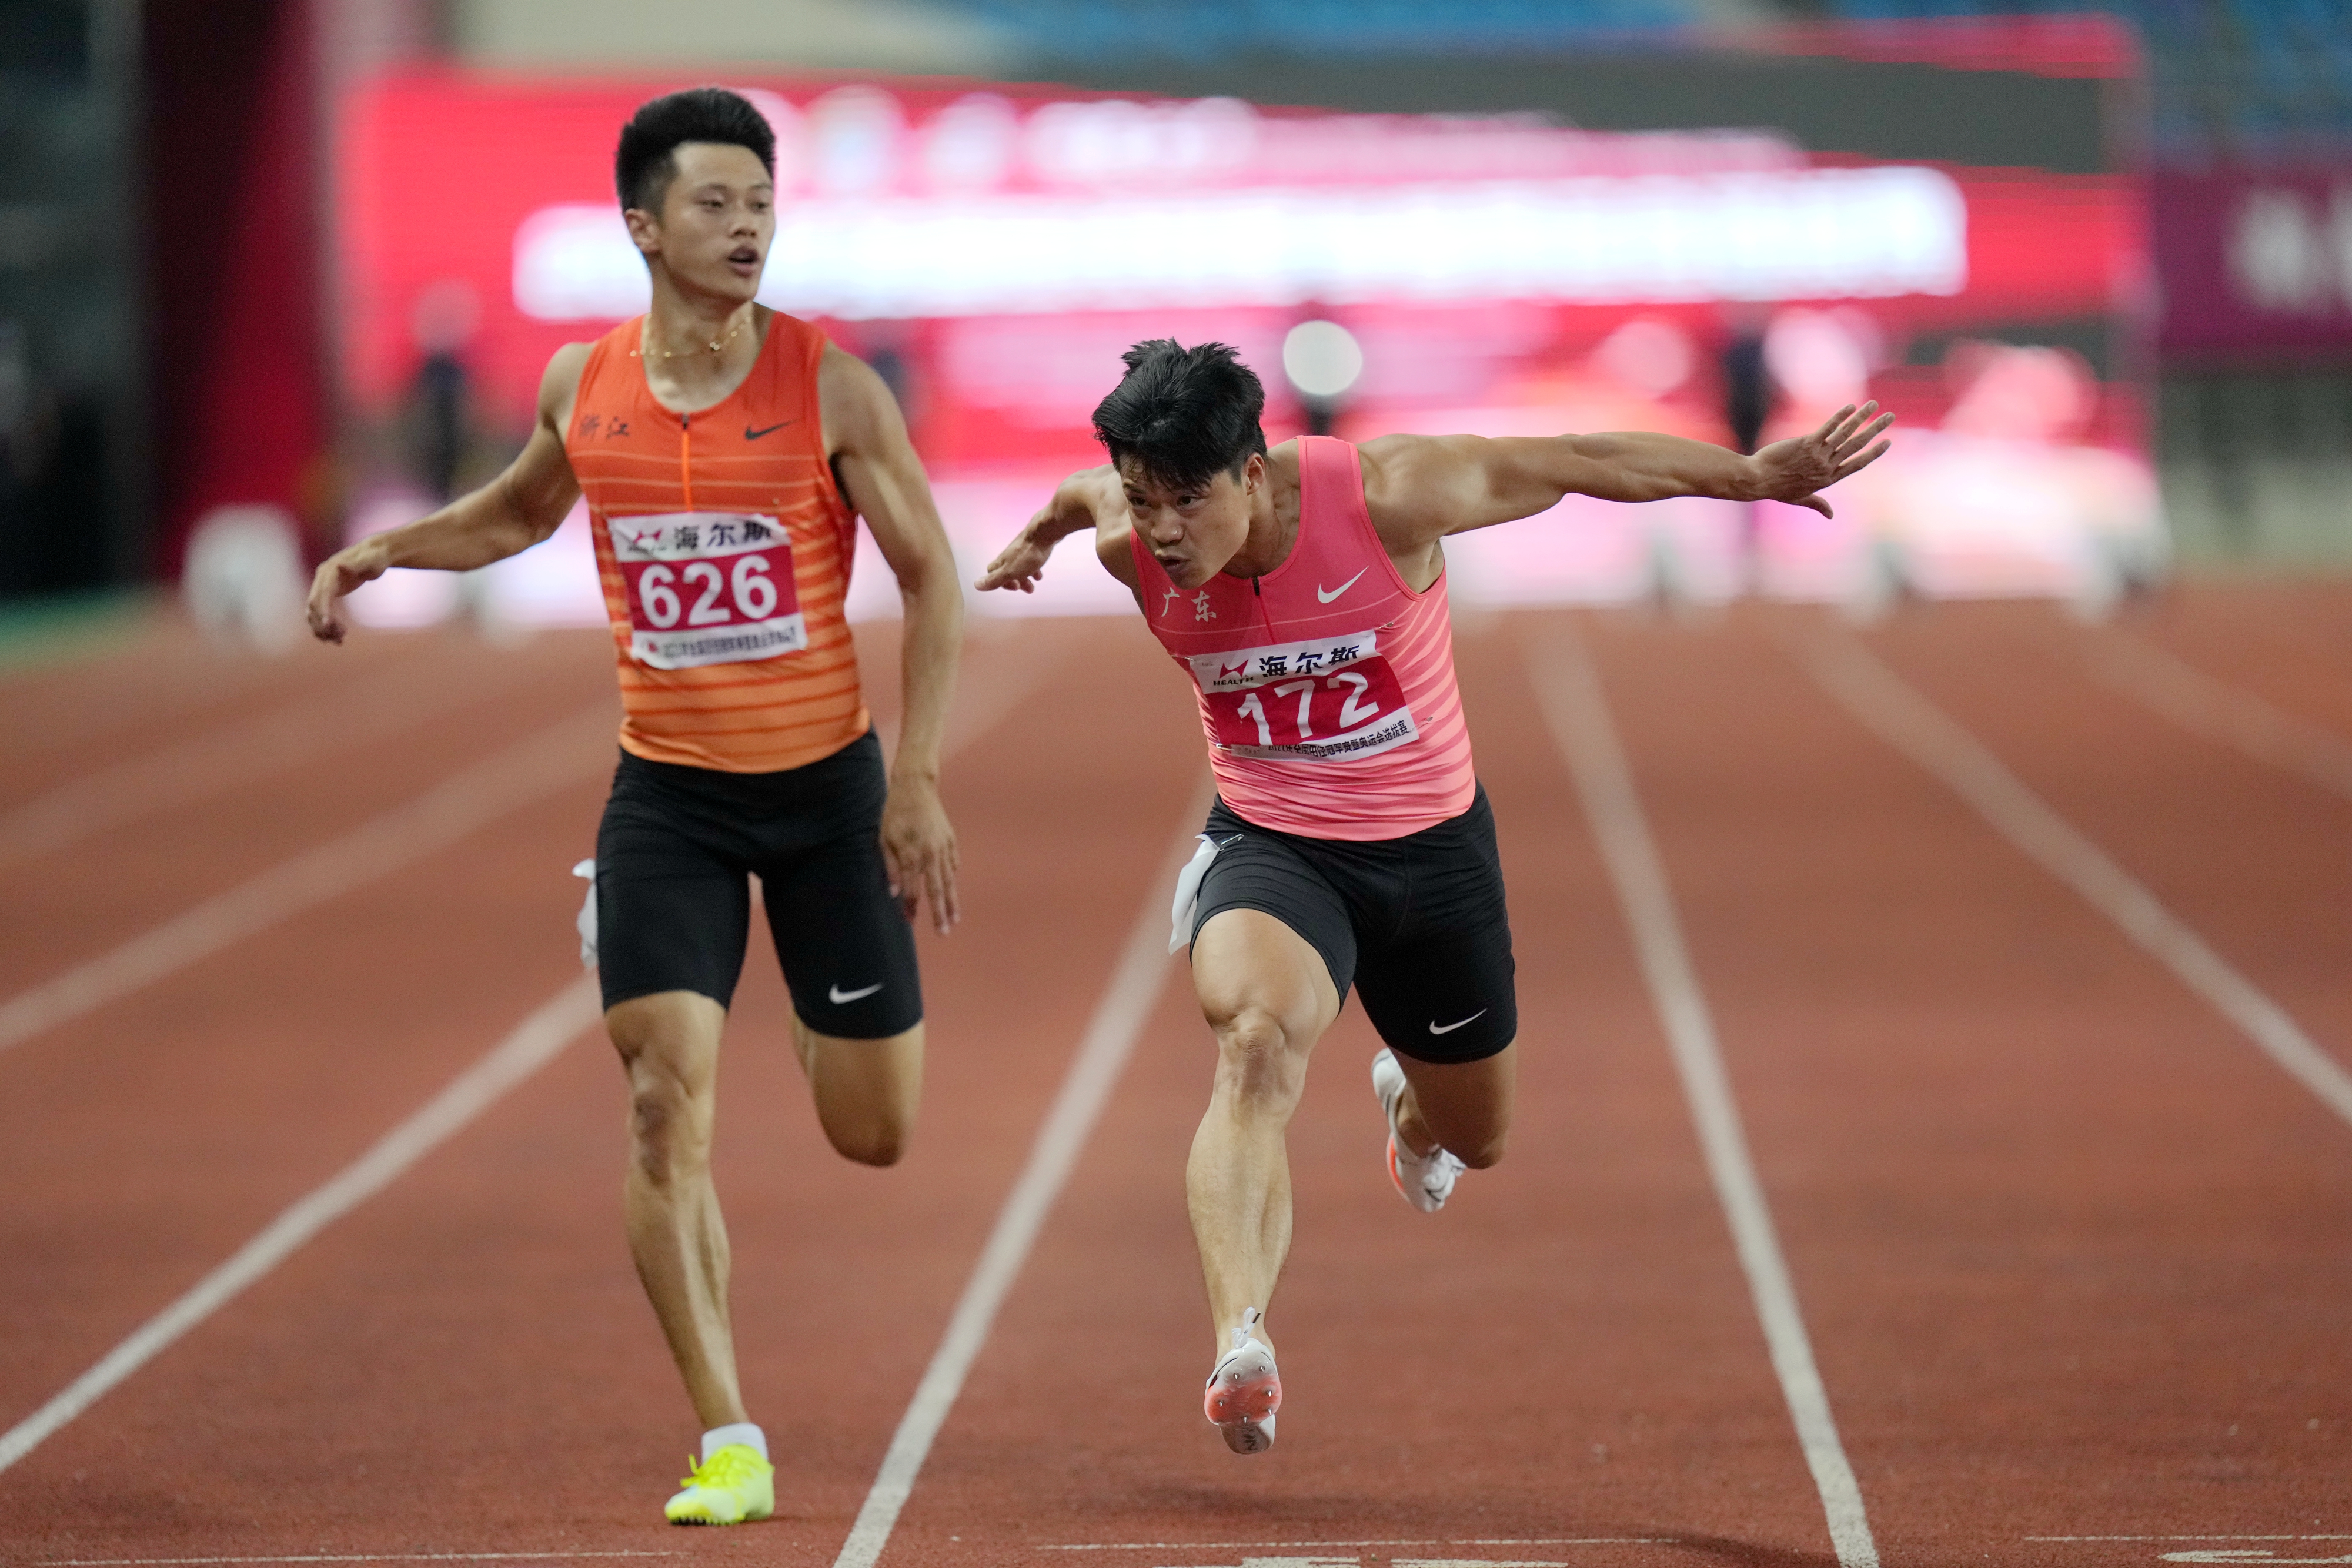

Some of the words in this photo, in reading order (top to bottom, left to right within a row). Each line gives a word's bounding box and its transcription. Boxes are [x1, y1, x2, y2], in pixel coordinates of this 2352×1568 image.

[639, 554, 777, 628] 626
[1161, 587, 1217, 622] 广东
[1259, 645, 1359, 677] 海尔斯
[1213, 677, 1254, 686] HEALTH
[1237, 672, 1379, 745] 172
